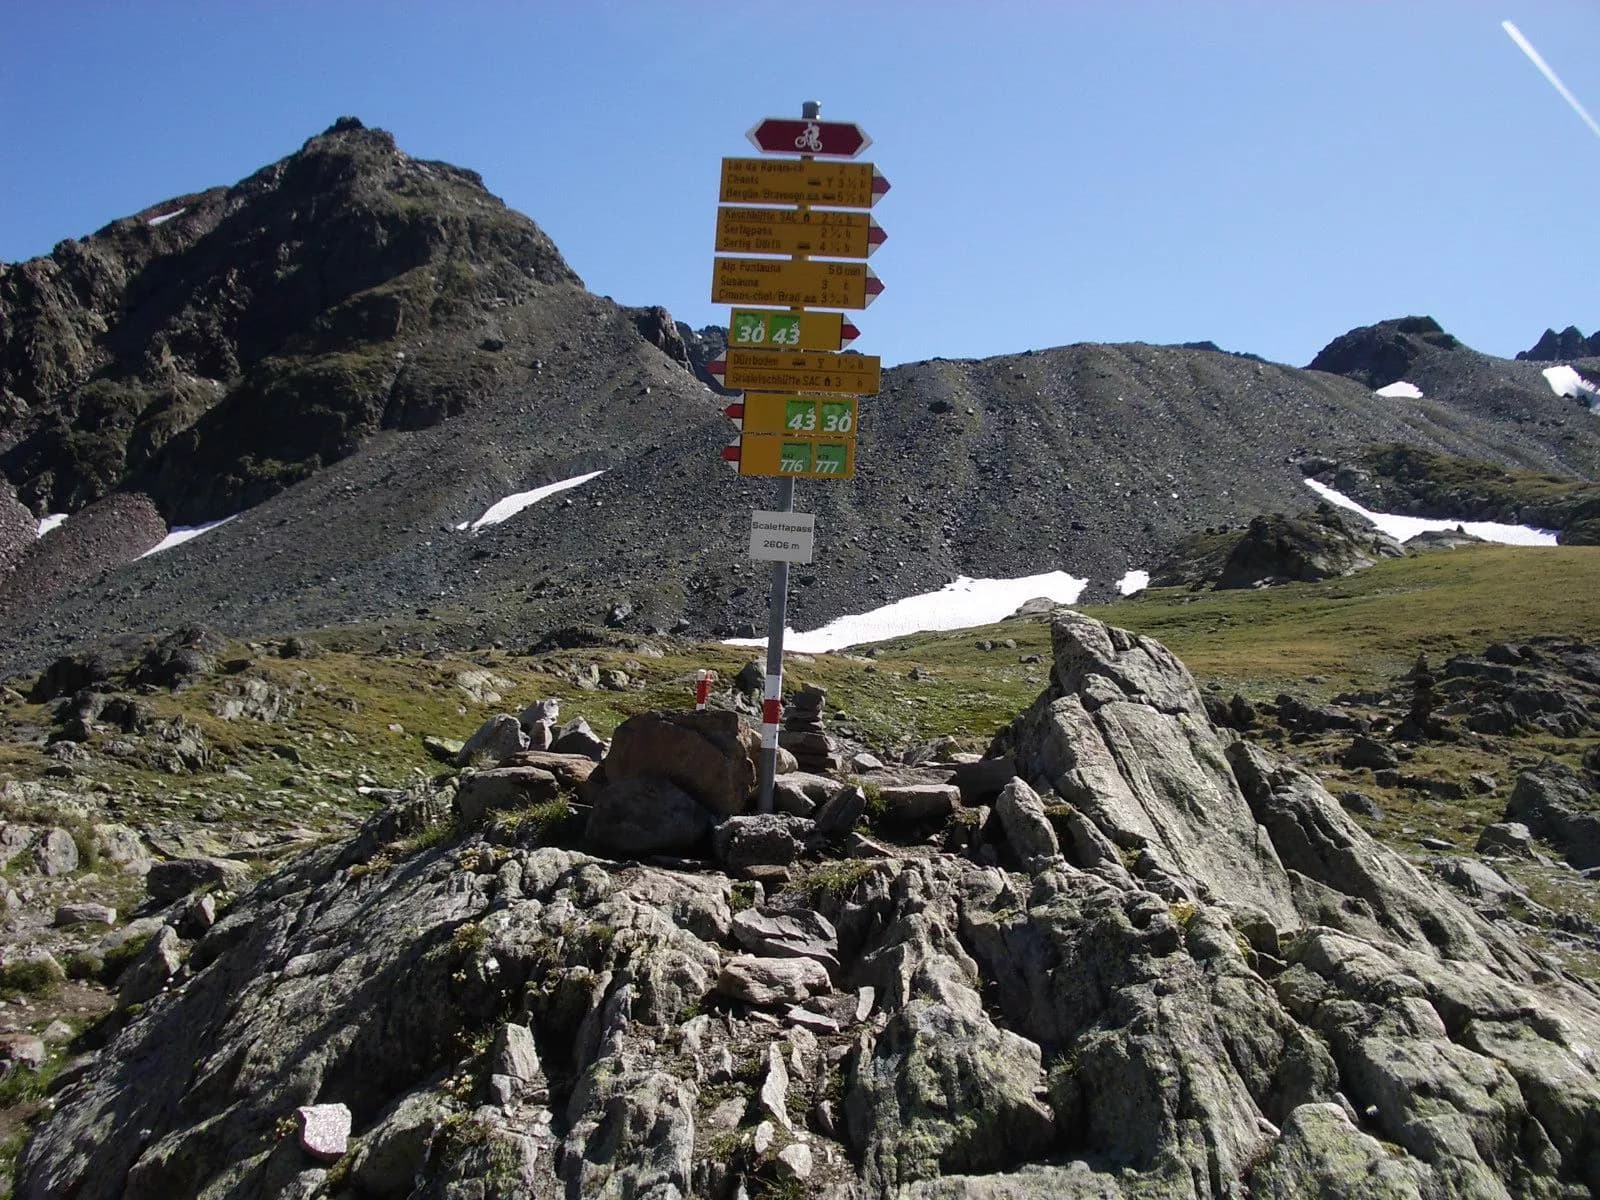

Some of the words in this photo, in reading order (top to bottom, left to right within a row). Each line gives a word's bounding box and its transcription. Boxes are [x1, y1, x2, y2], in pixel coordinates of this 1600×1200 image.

[724, 224, 773, 237] Sertigpass
[720, 261, 736, 273] Alp
[736, 326, 766, 343] 30
[772, 327, 801, 345] 43
[802, 375, 822, 387] SAC
[788, 413, 817, 431] 43
[823, 414, 853, 433] 30
[780, 459, 804, 473] 776
[815, 460, 839, 474] 777
[752, 521, 813, 533] Scalettapass
[763, 539, 790, 550] 2606
